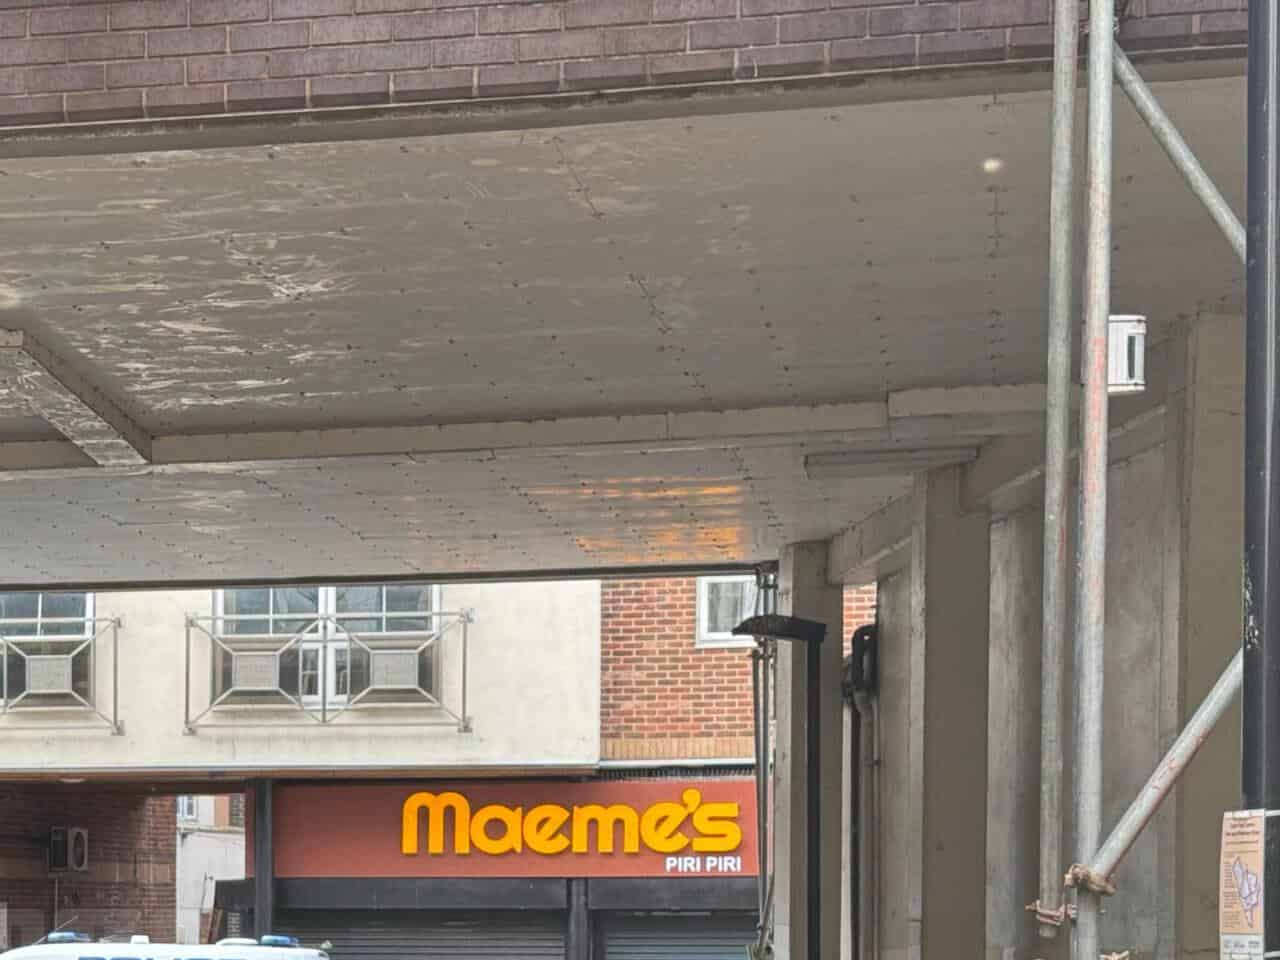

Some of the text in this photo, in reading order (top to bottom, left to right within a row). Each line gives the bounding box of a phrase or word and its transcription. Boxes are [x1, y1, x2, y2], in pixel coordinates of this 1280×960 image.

[401, 788, 743, 856] Maeme's
[666, 856, 742, 872] PIRI PIRI
